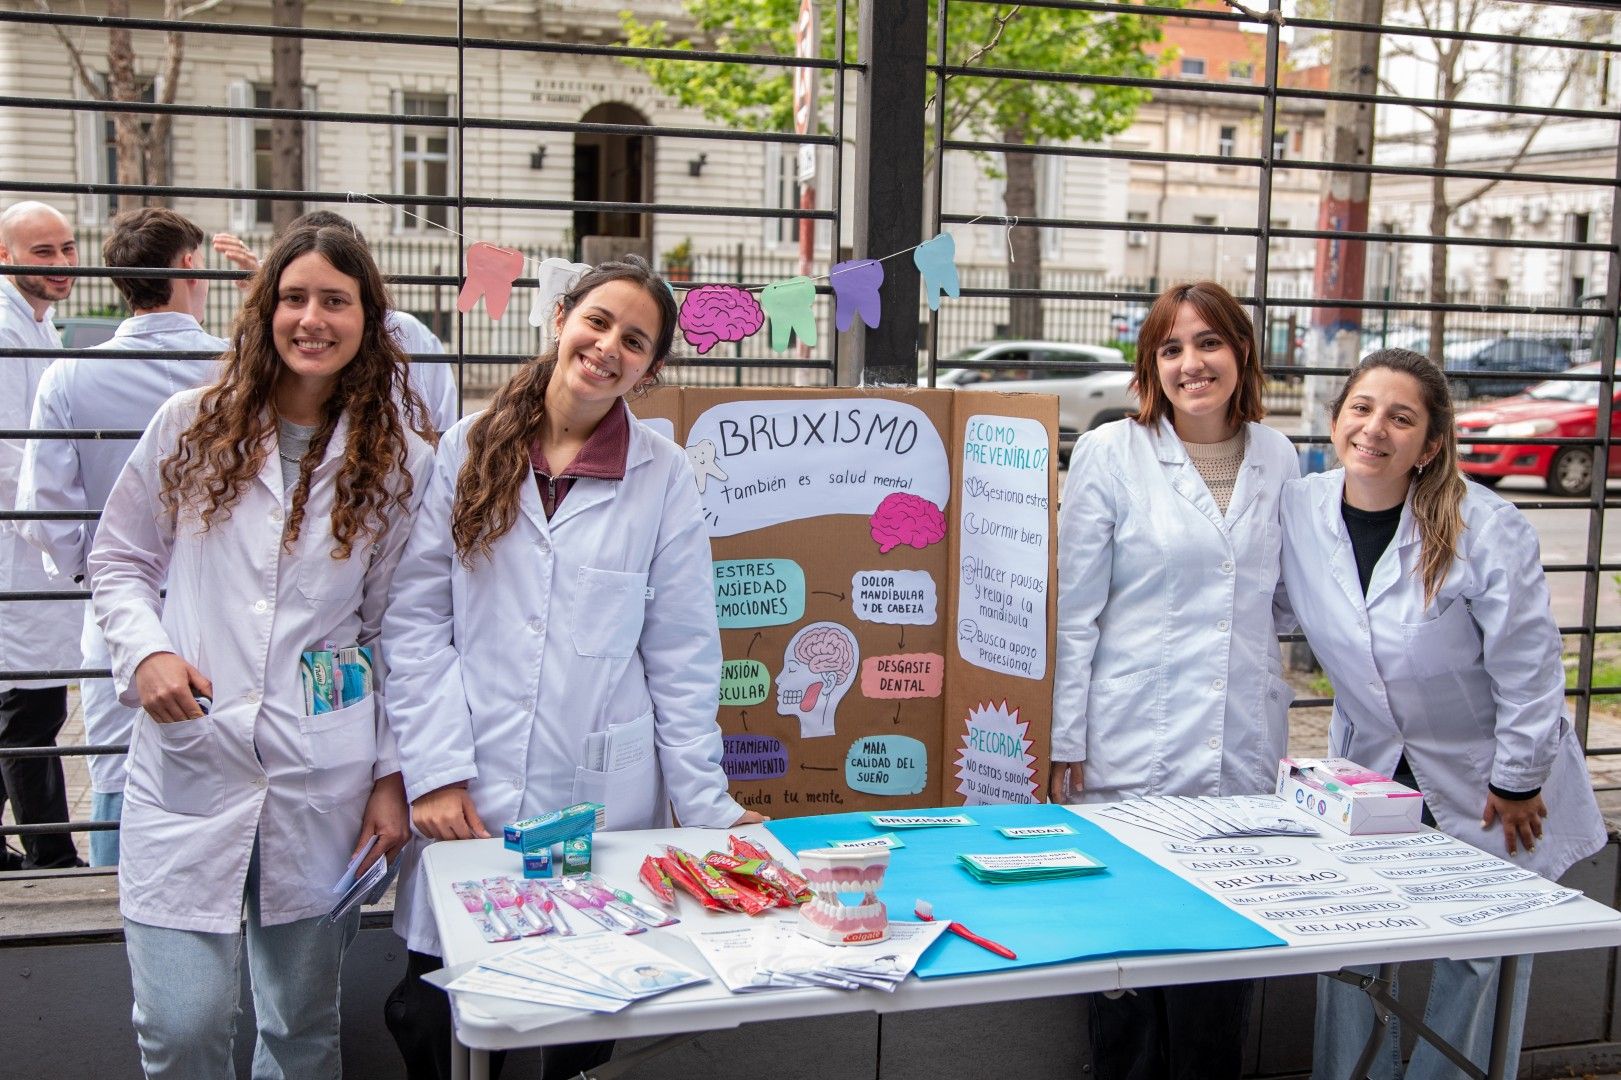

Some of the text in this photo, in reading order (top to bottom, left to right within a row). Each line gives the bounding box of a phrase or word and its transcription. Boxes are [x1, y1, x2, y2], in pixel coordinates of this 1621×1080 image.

[719, 409, 918, 457] BRUXISMO
[965, 443, 1048, 471] PREVENIRLO?
[721, 470, 912, 504] también es salud mental
[983, 481, 1024, 504] Gestiona
[981, 518, 1042, 547] Dormir bien
[716, 562, 775, 578] ESTRES
[976, 559, 1044, 593] Hacer pausas
[718, 579, 787, 597] NSIEDAD
[861, 576, 895, 587] DOLOR
[860, 587, 924, 601] MANDIBULAR
[871, 603, 883, 613] DE
[887, 603, 924, 614] CABEZA
[1021, 597, 1033, 614] la
[977, 630, 1037, 658] Busca apoyo
[721, 661, 760, 680] ENSIÓN
[877, 660, 931, 674] DESGASTE
[719, 684, 766, 701] SCULAR
[880, 677, 925, 692] DENTAL
[723, 738, 780, 755] RETAMIENTO
[863, 742, 887, 755] MALA
[970, 727, 1024, 762] RECORDÁ
[723, 757, 785, 775] CHINAMIENTO
[851, 757, 915, 769] CALIDAD DEL
[857, 770, 889, 784] SUEÑO
[979, 763, 1001, 781] estas
[783, 789, 799, 804] tu
[977, 782, 1000, 798] salud
[1002, 789, 1031, 804] mental
[843, 840, 887, 848] MITOS
[1328, 834, 1445, 852] APRETAMIENTO
[1191, 856, 1292, 869] ANSIEDAD
[1382, 860, 1506, 877] MAYOR CANSANCIO
[1214, 871, 1338, 889] BRUXISMO
[1405, 872, 1532, 893] DESGASTE DENTAL
[1233, 896, 1267, 904] MALA
[1339, 885, 1380, 895] SUEÑO
[1265, 902, 1401, 918] APRETAMIENTO
[1448, 909, 1493, 924] DOLOR
[1295, 916, 1418, 932] RELAJACIÓN
[846, 931, 881, 941] Colgate
